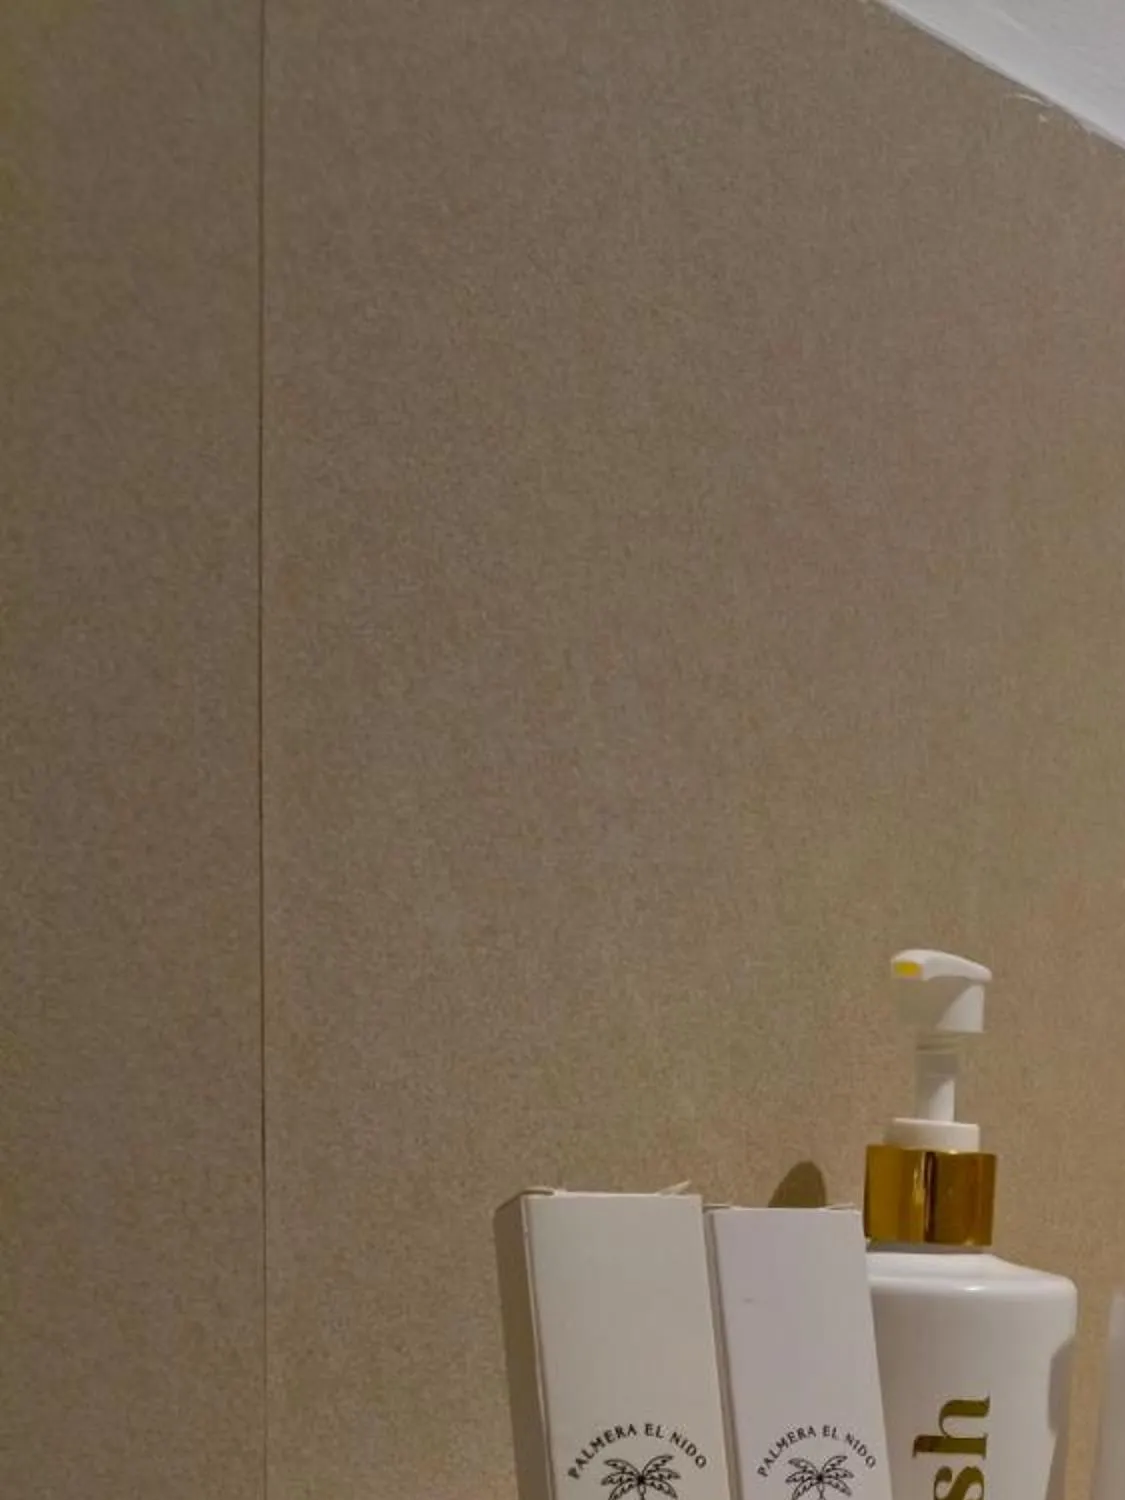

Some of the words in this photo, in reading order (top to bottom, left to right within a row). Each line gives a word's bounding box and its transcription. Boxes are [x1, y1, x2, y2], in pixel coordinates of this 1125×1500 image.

[568, 1424, 636, 1479] PALMERA
[645, 1423, 664, 1438] EL
[671, 1432, 707, 1468] NIDO
[757, 1427, 816, 1477] PALMERA
[823, 1425, 838, 1439] EL
[846, 1434, 876, 1469] NIDO
